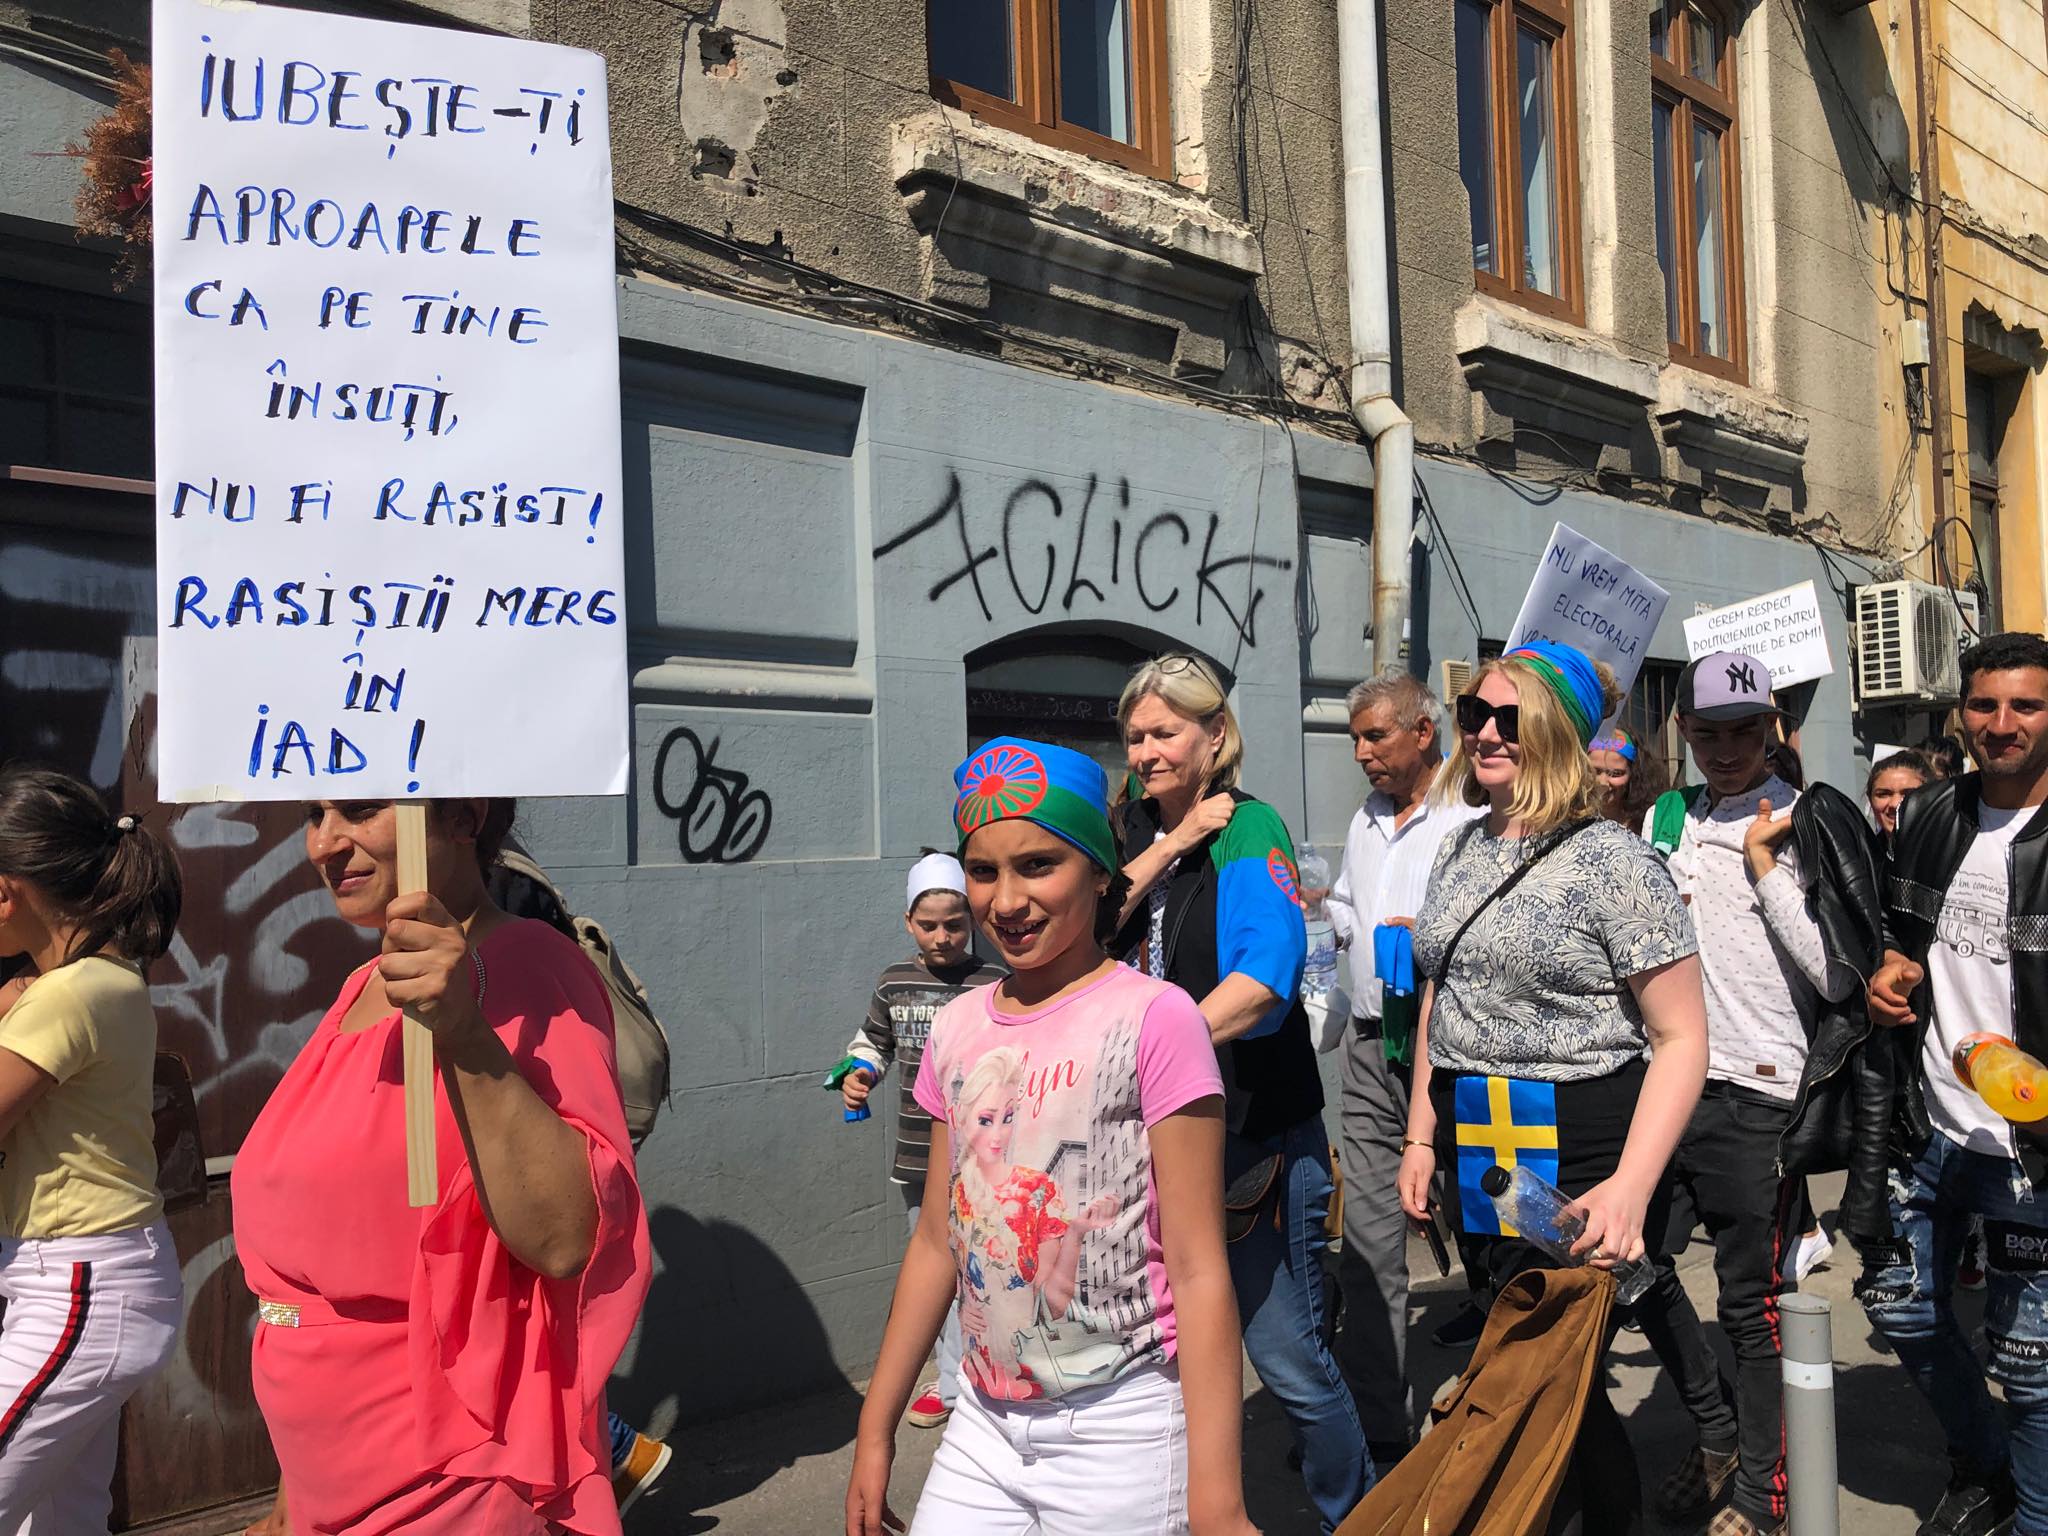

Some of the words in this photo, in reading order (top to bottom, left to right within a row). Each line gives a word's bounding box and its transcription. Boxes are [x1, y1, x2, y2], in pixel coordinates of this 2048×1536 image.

[182, 183, 541, 257] APROAPELE
[184, 279, 268, 331] CA
[317, 286, 373, 330] PE
[402, 290, 549, 344] TINE
[170, 477, 256, 523] NU
[284, 480, 333, 523] FI
[1547, 543, 1576, 574] NU
[1581, 559, 1618, 595] VREM
[475, 586, 618, 627] MERG
[1708, 610, 1744, 630] CEREM
[1747, 594, 1792, 621] RESPECT
[1774, 607, 1817, 631] PENTRU
[1771, 636, 1786, 651] DE
[342, 652, 406, 713] ÎN
[1725, 662, 1758, 694] NY
